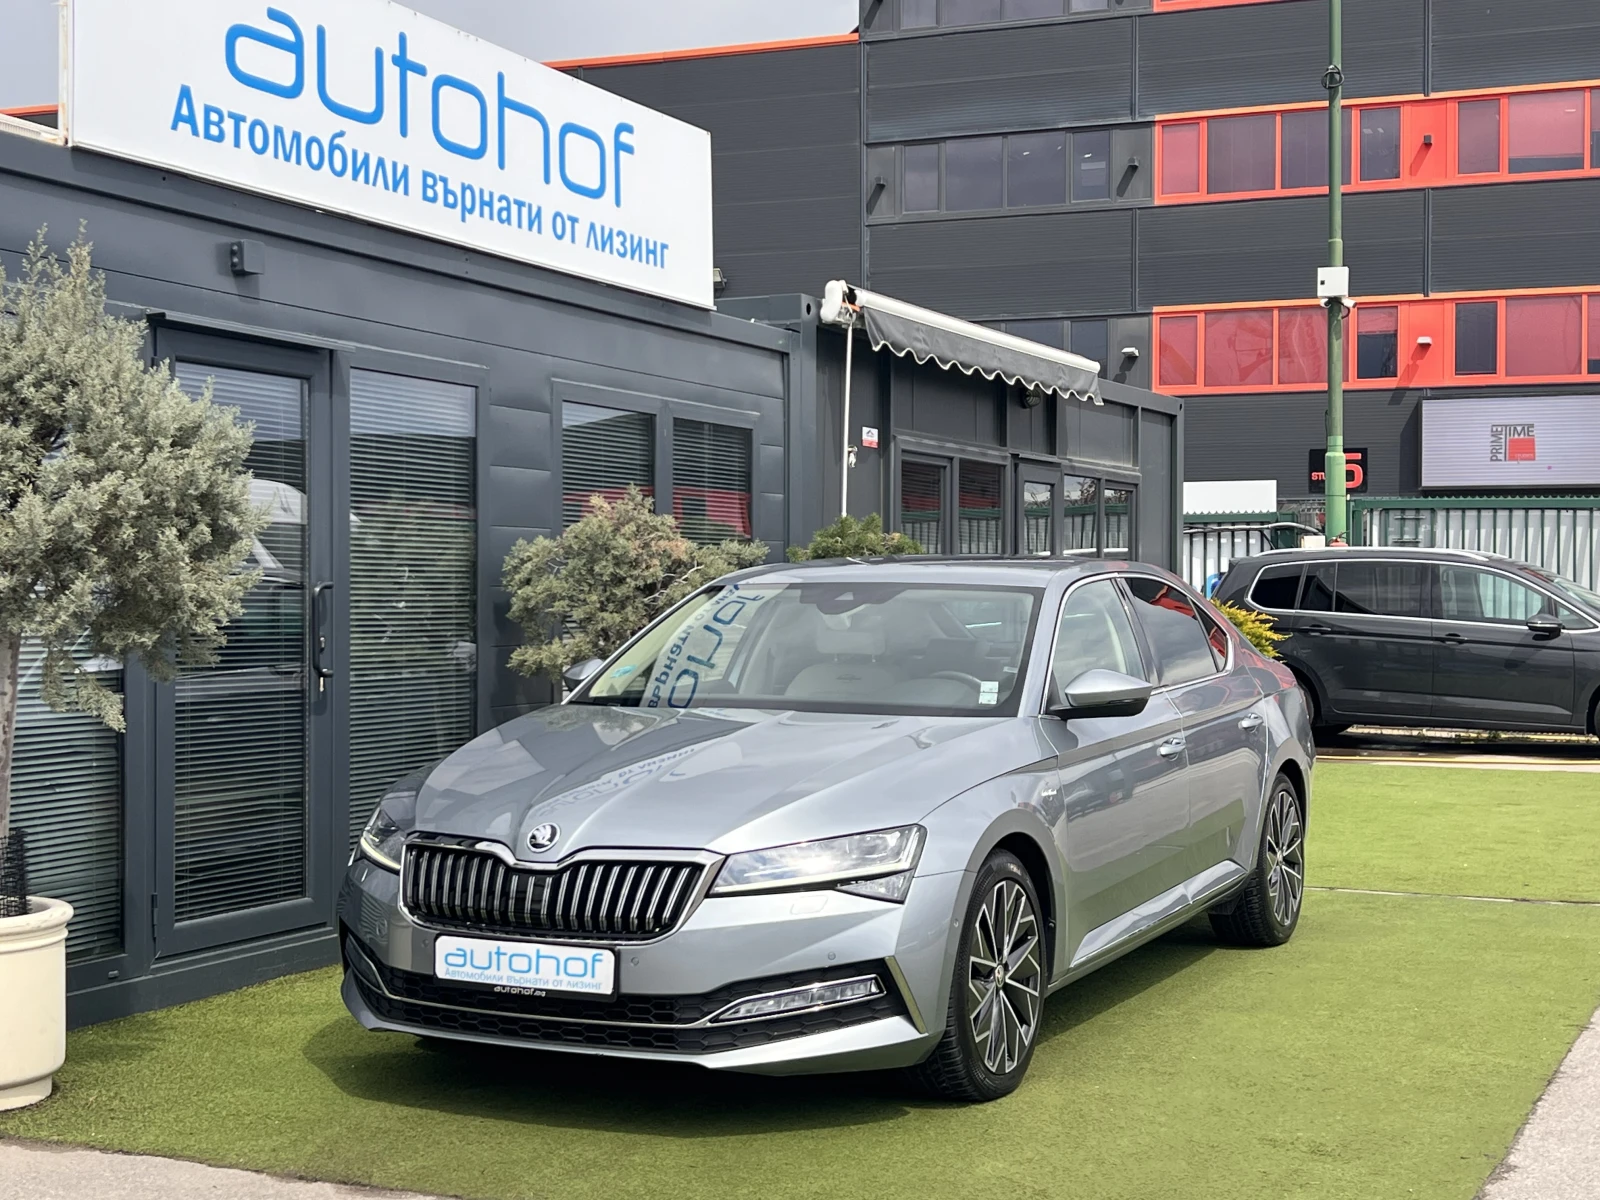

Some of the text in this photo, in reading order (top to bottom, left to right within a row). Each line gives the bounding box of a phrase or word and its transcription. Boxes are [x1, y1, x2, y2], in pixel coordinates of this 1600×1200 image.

[225, 6, 635, 207] autohof
[170, 84, 669, 269] Автомобили върнати от лизинг
[1490, 425, 1503, 461] PRIME
[444, 946, 604, 979] autohof
[444, 967, 603, 991] Автомобили върнати от лизинг
